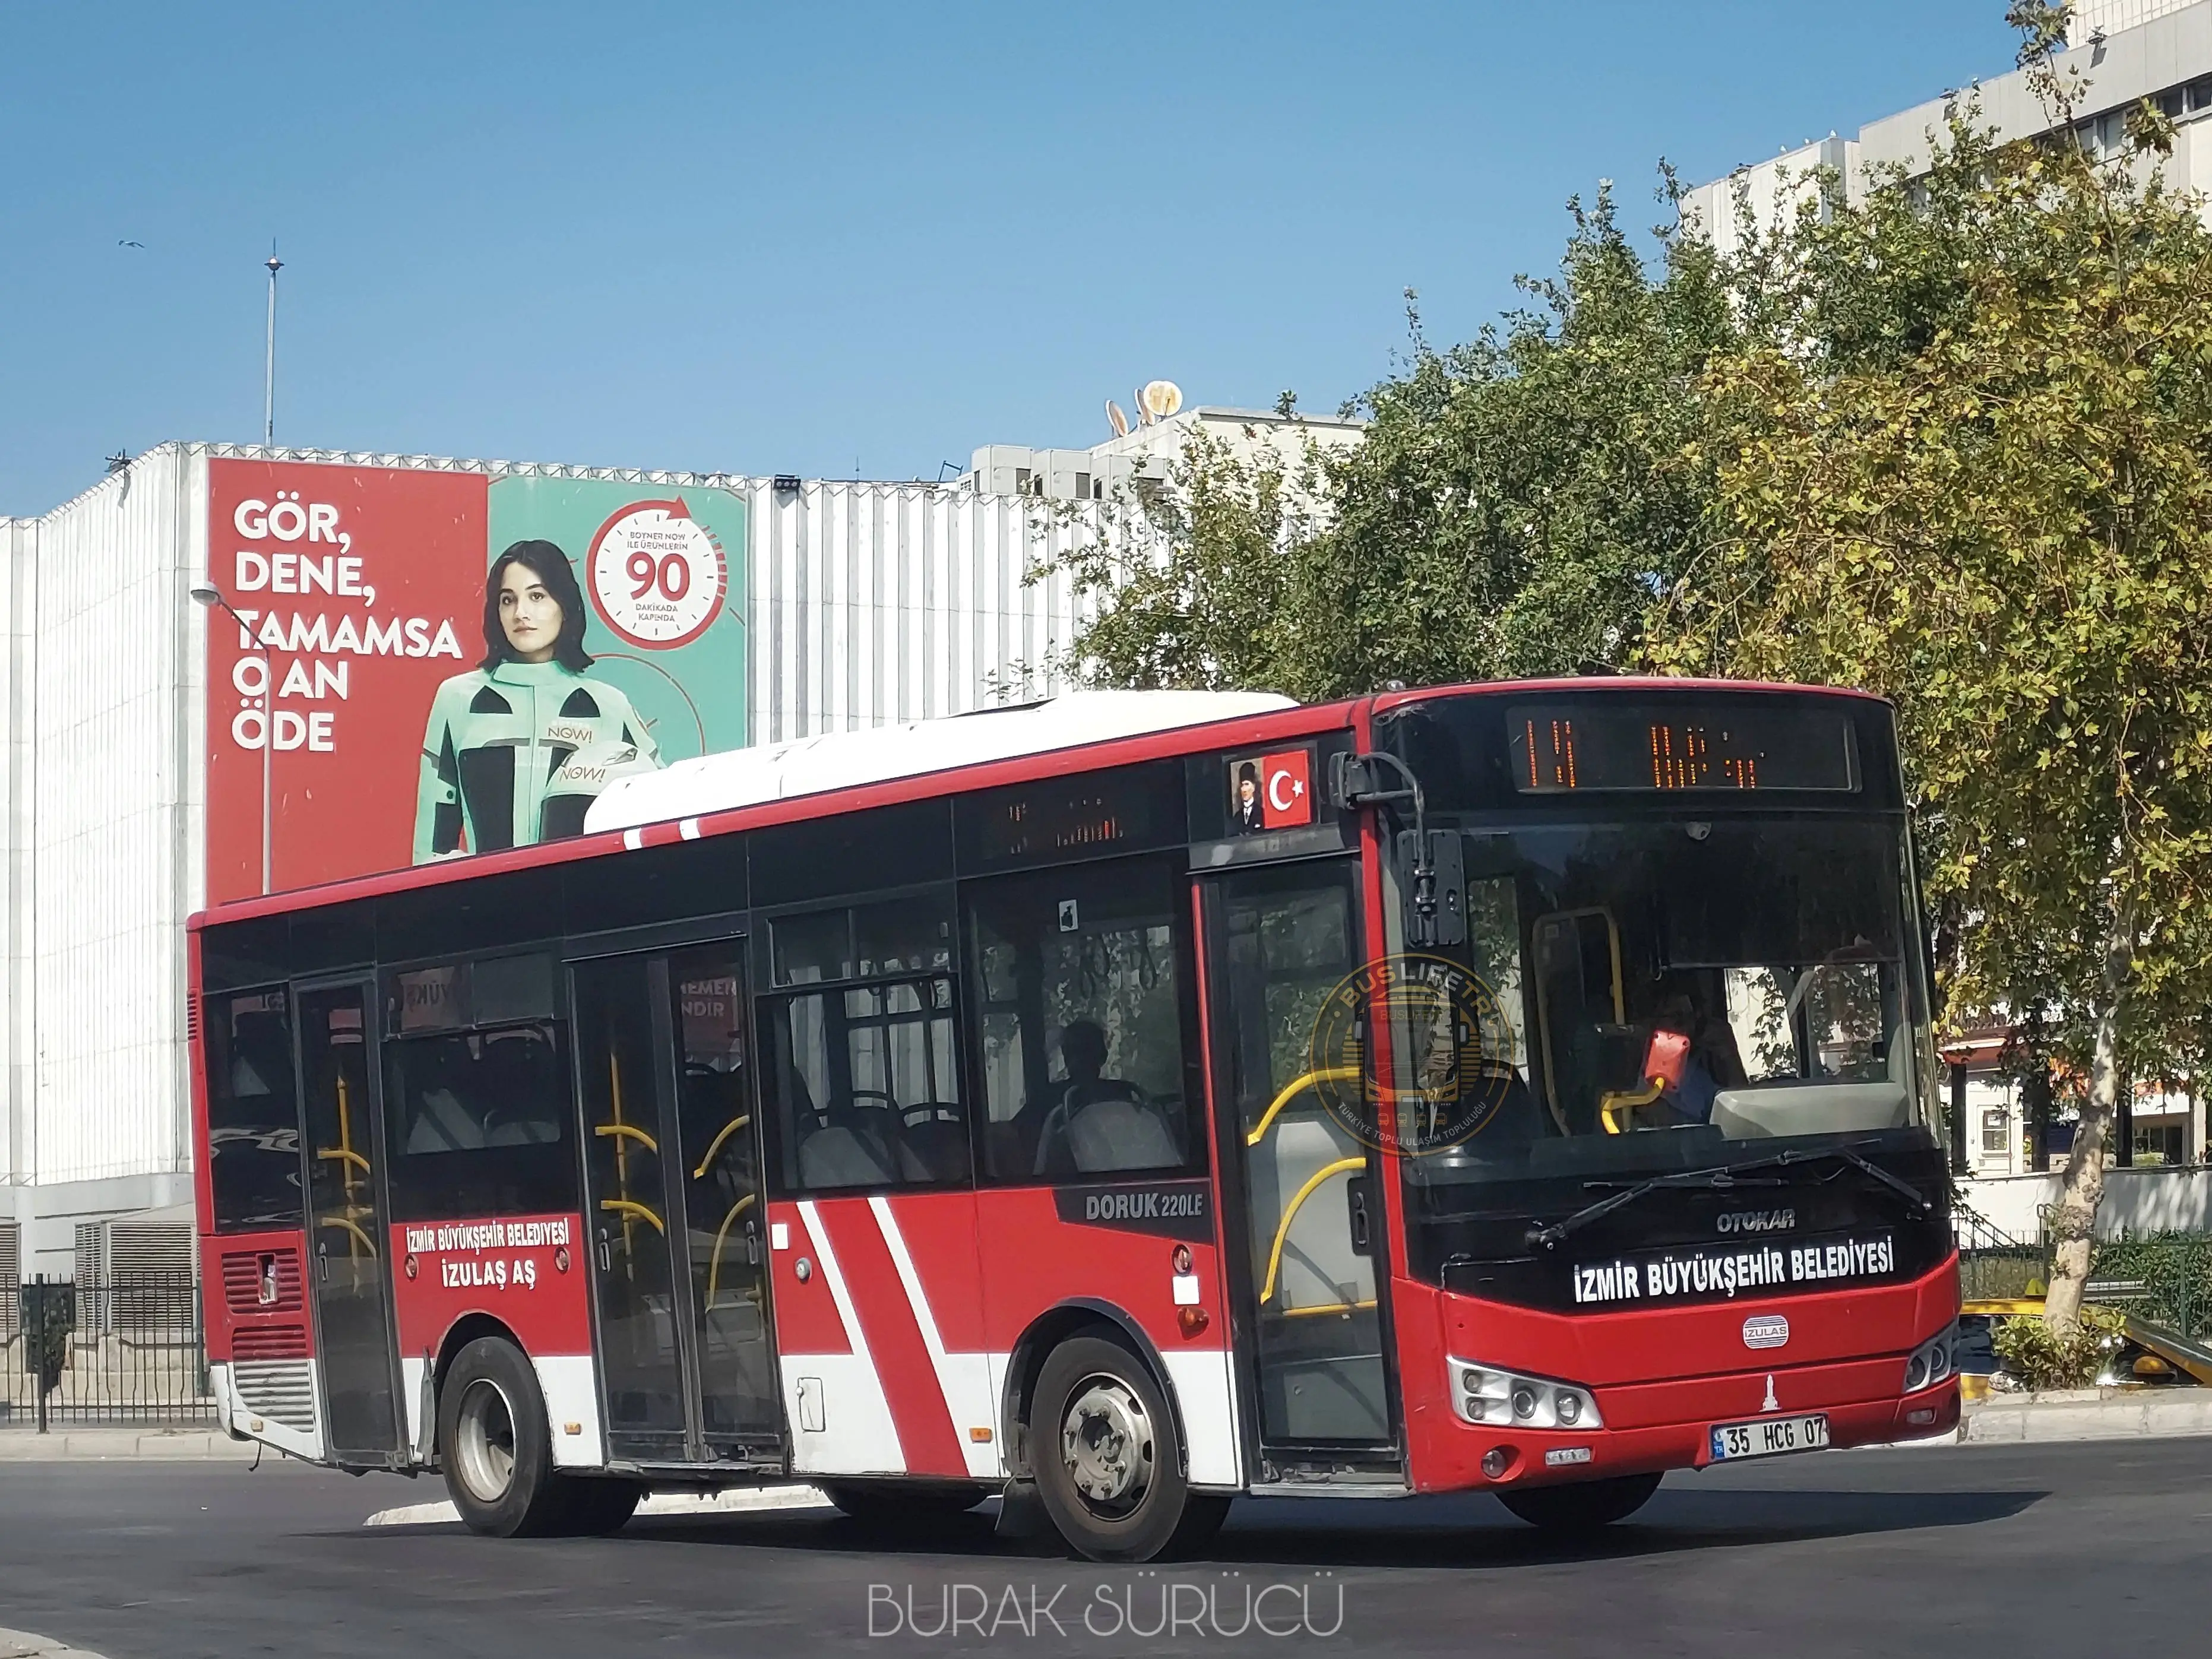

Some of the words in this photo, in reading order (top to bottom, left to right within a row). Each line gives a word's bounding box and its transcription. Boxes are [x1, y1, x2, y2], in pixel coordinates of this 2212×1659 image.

[234, 490, 351, 554] GÖR,
[236, 552, 375, 607] DENE,
[626, 551, 690, 601] 90
[232, 609, 463, 659] TAMAMSA
[232, 657, 271, 696] O
[278, 658, 348, 700] AN
[232, 698, 334, 752] ÖDE
[548, 727, 592, 743] NOW!
[559, 767, 606, 783] NOW!
[1086, 1193, 1159, 1220] DORUK
[1162, 1193, 1203, 1217] 220LE
[1717, 1209, 1795, 1233] OTOKAR
[406, 1226, 436, 1253] İZMİR
[438, 1220, 506, 1256] BÜYÜKŞEHİR
[441, 1258, 507, 1291] İZULAŞ
[512, 1259, 536, 1291] AŞ
[1574, 1260, 1641, 1303] İZMİR
[1648, 1247, 1786, 1297] BÜYÜKŞEHİR
[1791, 1235, 1894, 1280] BELEDİYESİ
[1727, 1428, 1750, 1454] 35
[1763, 1423, 1795, 1451] HCG
[1803, 1417, 1824, 1445] 07
